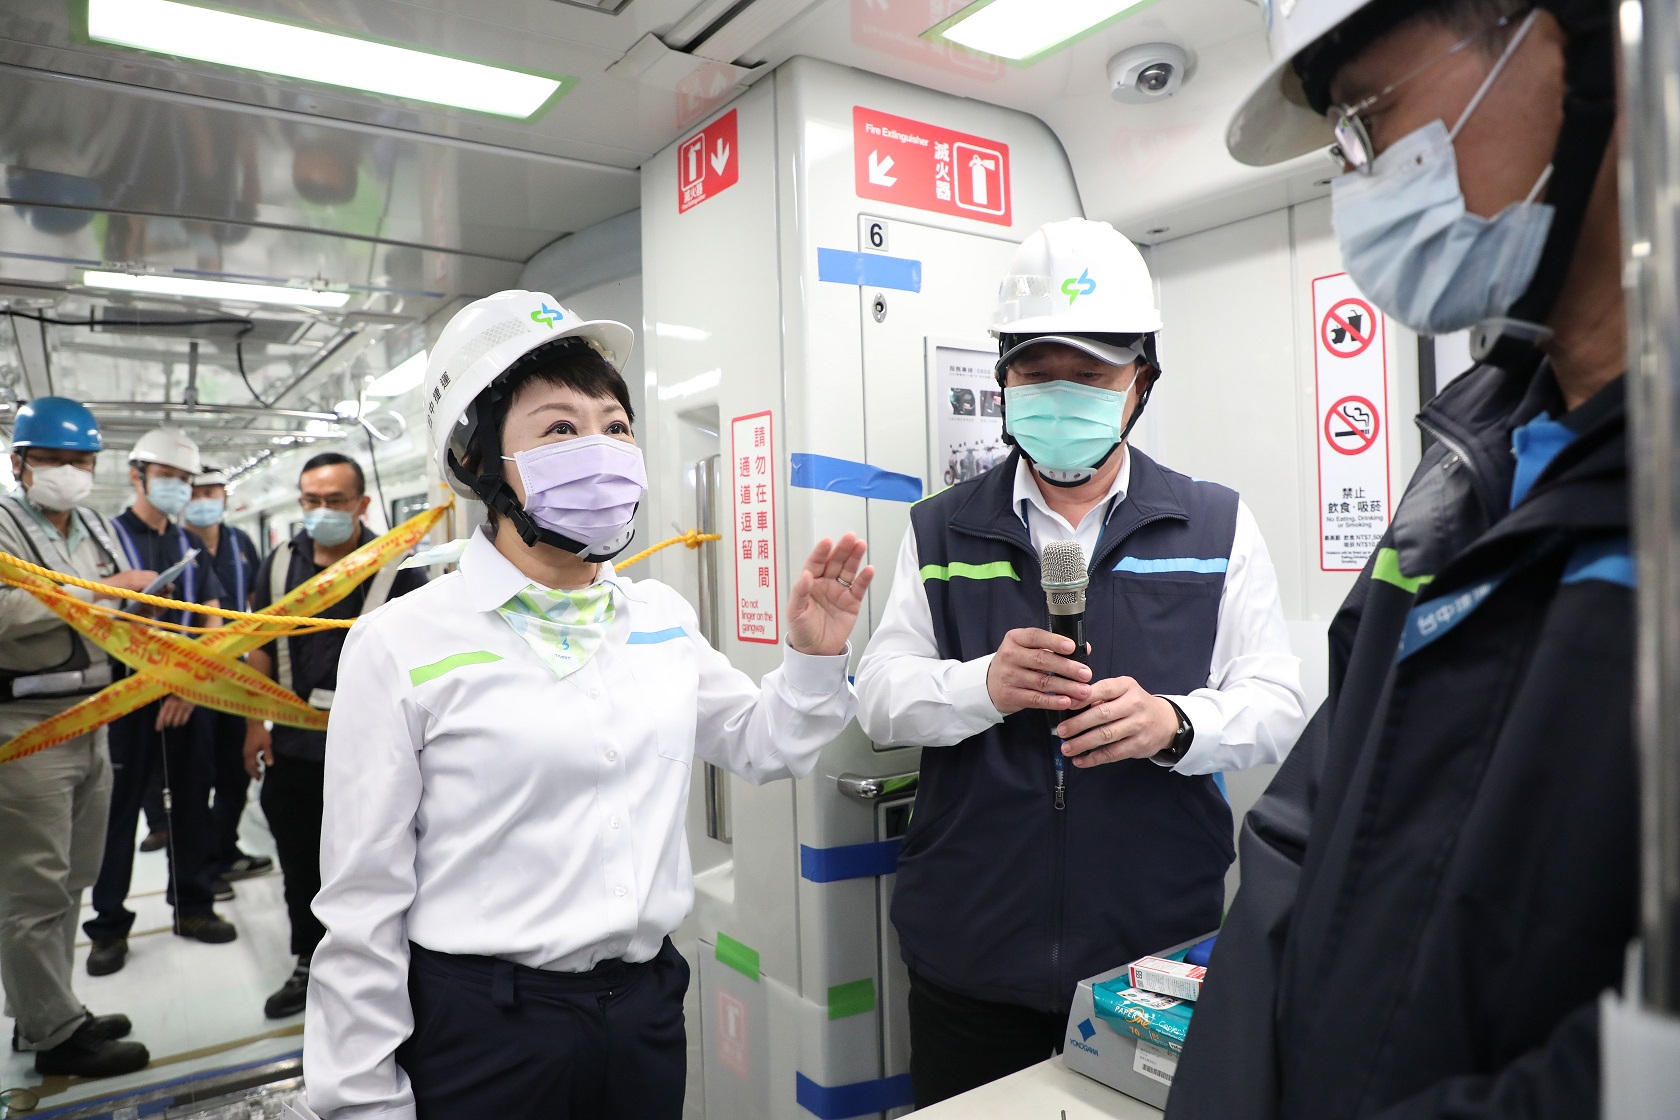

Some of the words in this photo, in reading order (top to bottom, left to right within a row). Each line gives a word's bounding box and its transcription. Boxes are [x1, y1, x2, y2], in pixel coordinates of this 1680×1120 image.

[865, 123, 881, 136] Fire
[882, 127, 930, 147] Extinguisher
[934, 141, 952, 202] 滅火器
[870, 223, 884, 248] 6
[1342, 486, 1366, 500] 禁止
[739, 456, 753, 560] 通道逗留
[754, 426, 770, 588] 請勿在車廂間
[742, 598, 748, 608] Do
[750, 599, 759, 608] not
[742, 610, 757, 622] linger
[764, 611, 773, 621] the
[742, 623, 766, 635] gangway
[1069, 1038, 1099, 1057] YOKOGAWA
